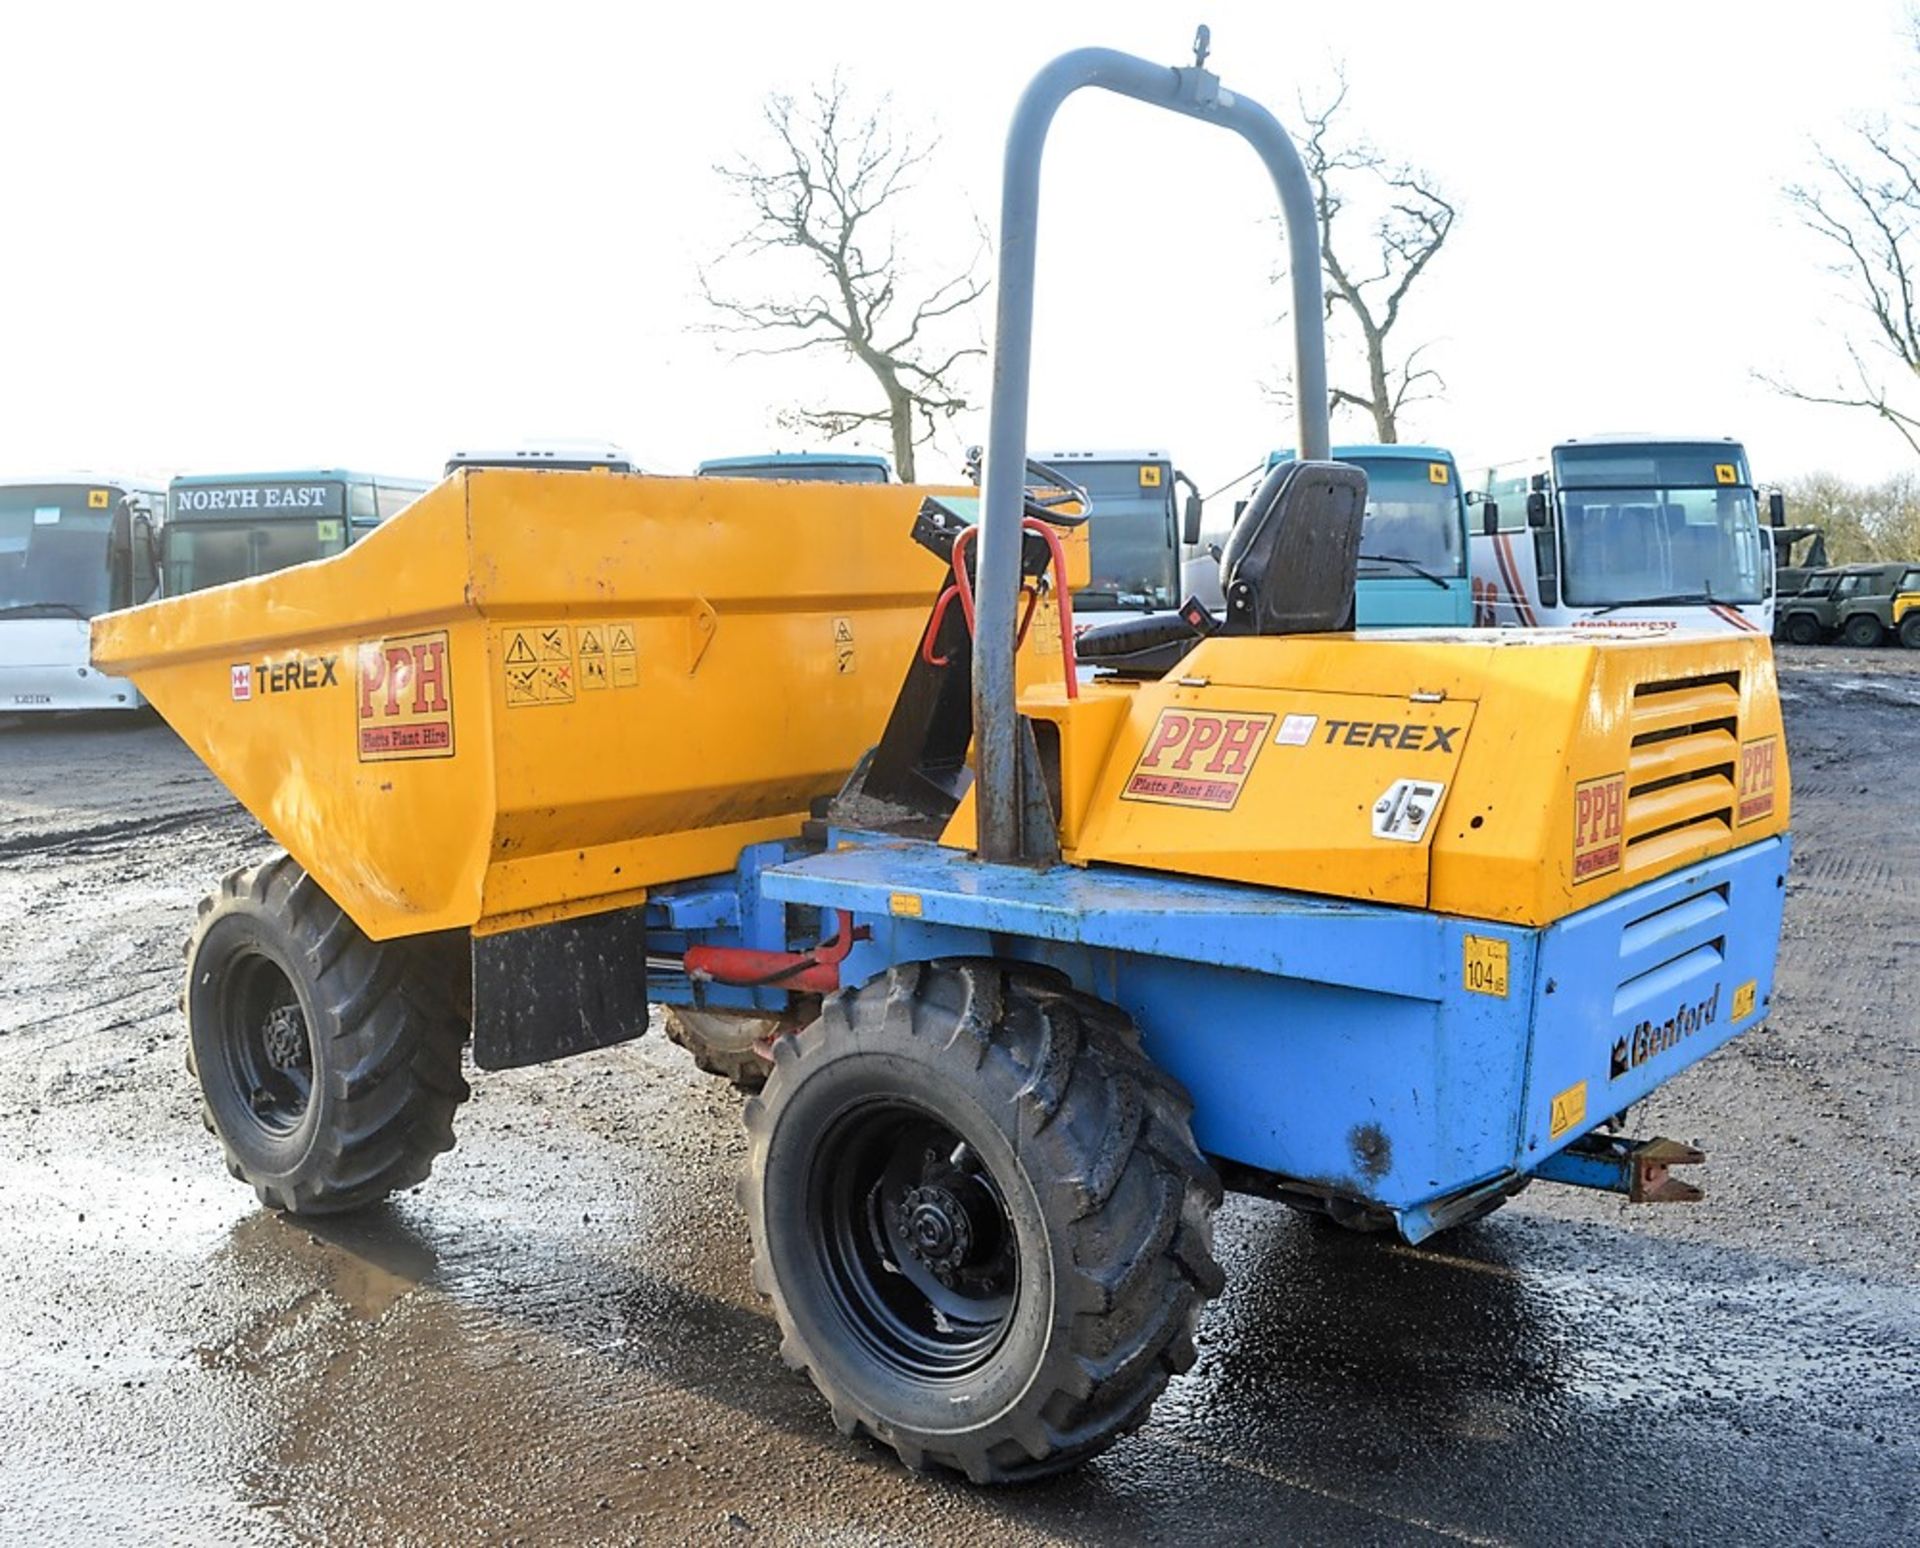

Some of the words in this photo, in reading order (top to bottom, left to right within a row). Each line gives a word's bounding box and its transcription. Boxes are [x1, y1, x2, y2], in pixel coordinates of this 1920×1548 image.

[178, 489, 259, 511] NORTH
[264, 488, 326, 508] EAST
[255, 656, 339, 694] TEREX
[361, 642, 447, 719] PPH
[392, 730, 420, 747] Plant
[423, 728, 447, 745] Hire
[1141, 715, 1266, 775] PPH
[1325, 720, 1461, 754] TEREX
[1741, 742, 1775, 796] PPH
[1133, 777, 1167, 793] Platts
[1169, 781, 1203, 797] Plant
[1204, 784, 1233, 800] Hire
[1576, 782, 1623, 847] PPH
[1468, 960, 1493, 990] 104
[1632, 982, 1721, 1068] Benford
